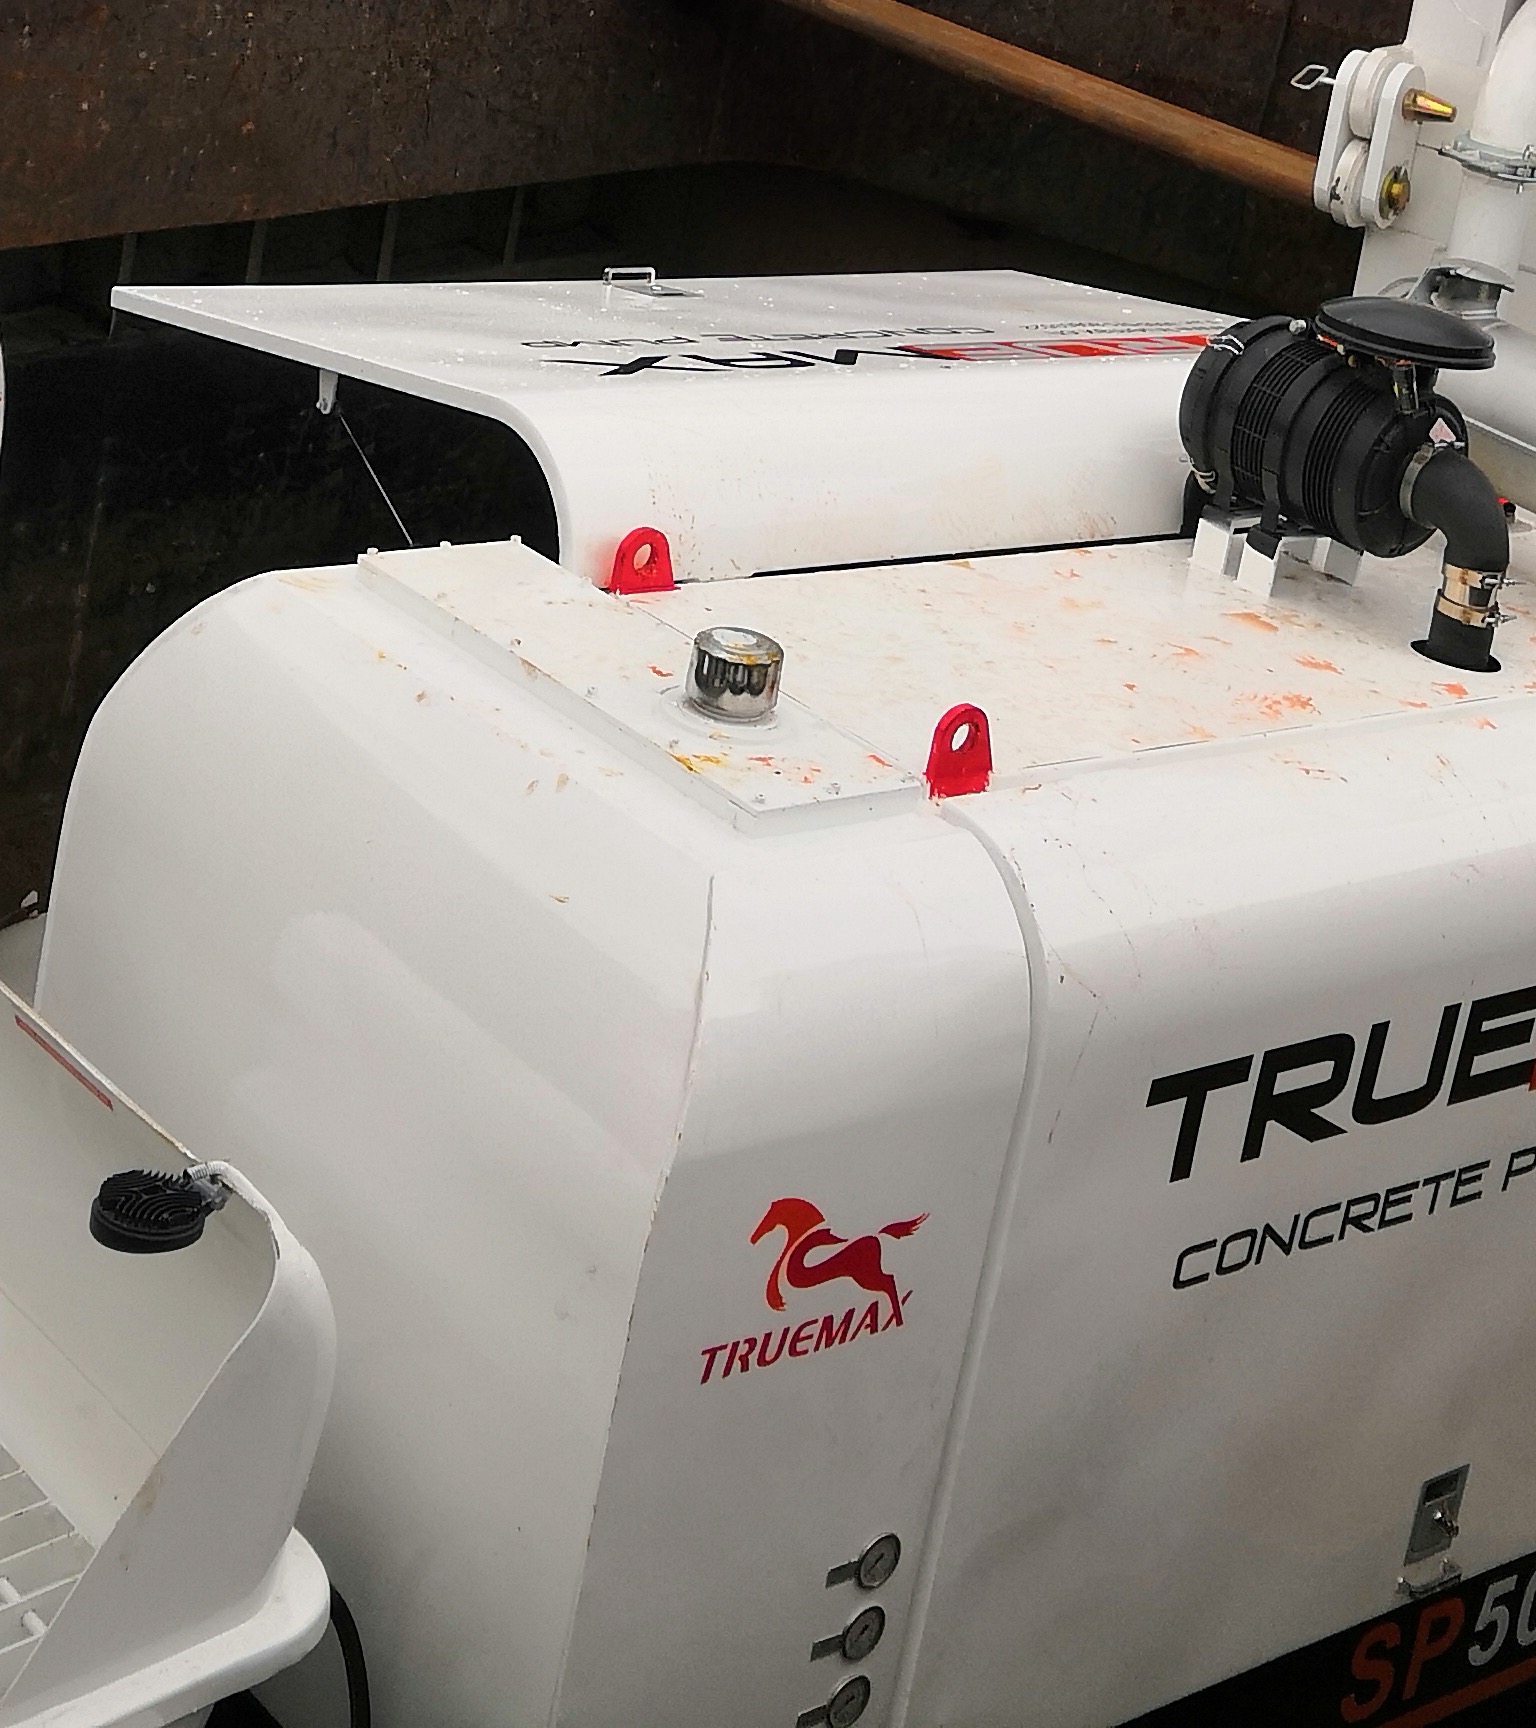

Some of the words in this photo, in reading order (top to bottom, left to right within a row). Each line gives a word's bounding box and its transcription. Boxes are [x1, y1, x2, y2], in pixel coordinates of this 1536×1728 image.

[539, 334, 1208, 376] RUEMAX
[1172, 1159, 1491, 1291] CONCRETE
[700, 1289, 914, 1386] TRUEMAX
